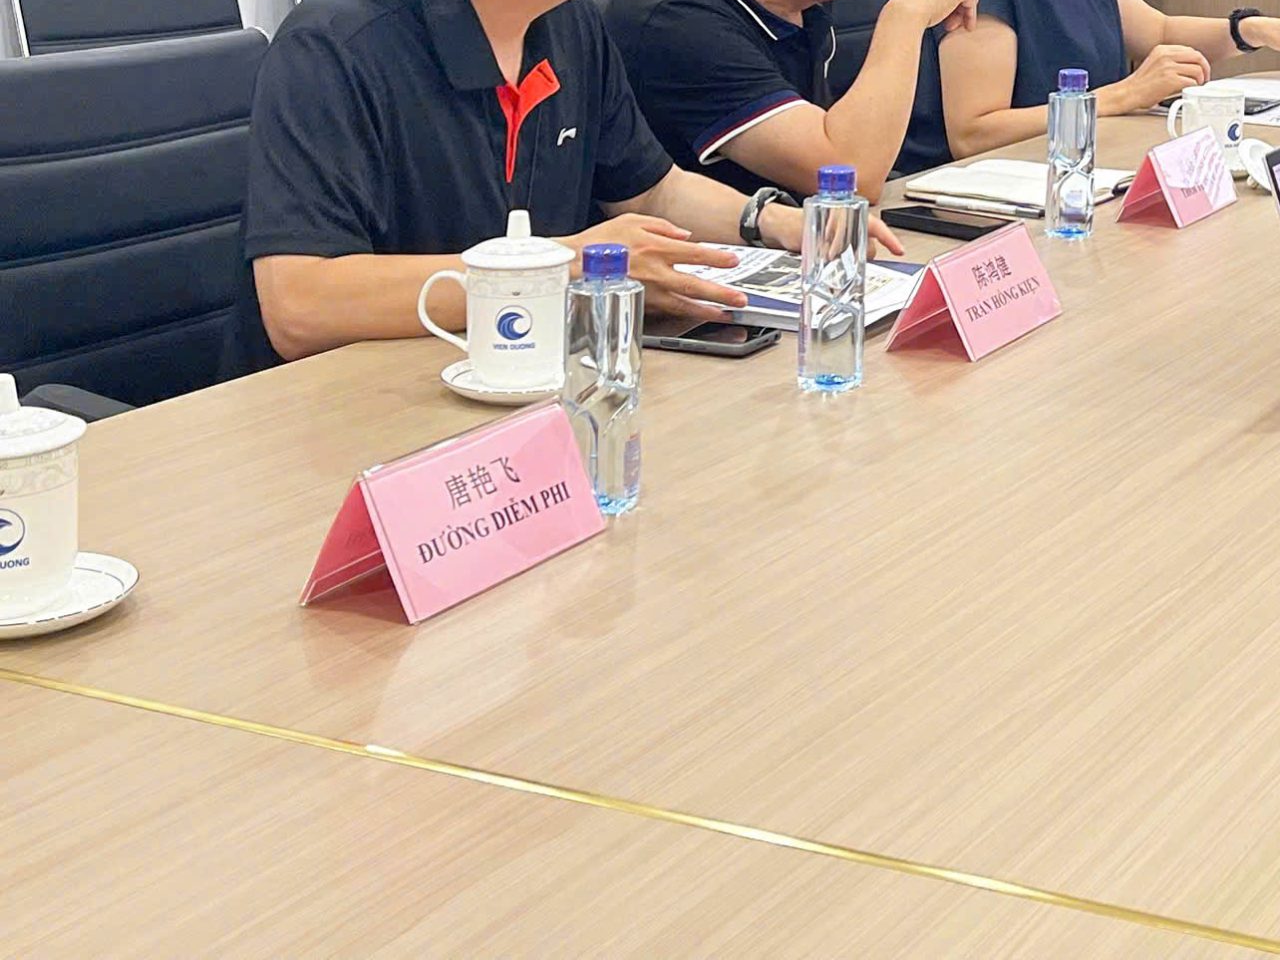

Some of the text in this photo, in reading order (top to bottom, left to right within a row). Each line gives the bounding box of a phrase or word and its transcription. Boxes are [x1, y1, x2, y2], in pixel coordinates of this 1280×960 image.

[971, 256, 1012, 290] 陈鸿健
[444, 457, 521, 510] 唐艳飞
[418, 517, 490, 564] ĐƯỜNG
[541, 480, 572, 512] PHI
[0, 557, 30, 569] UONG
